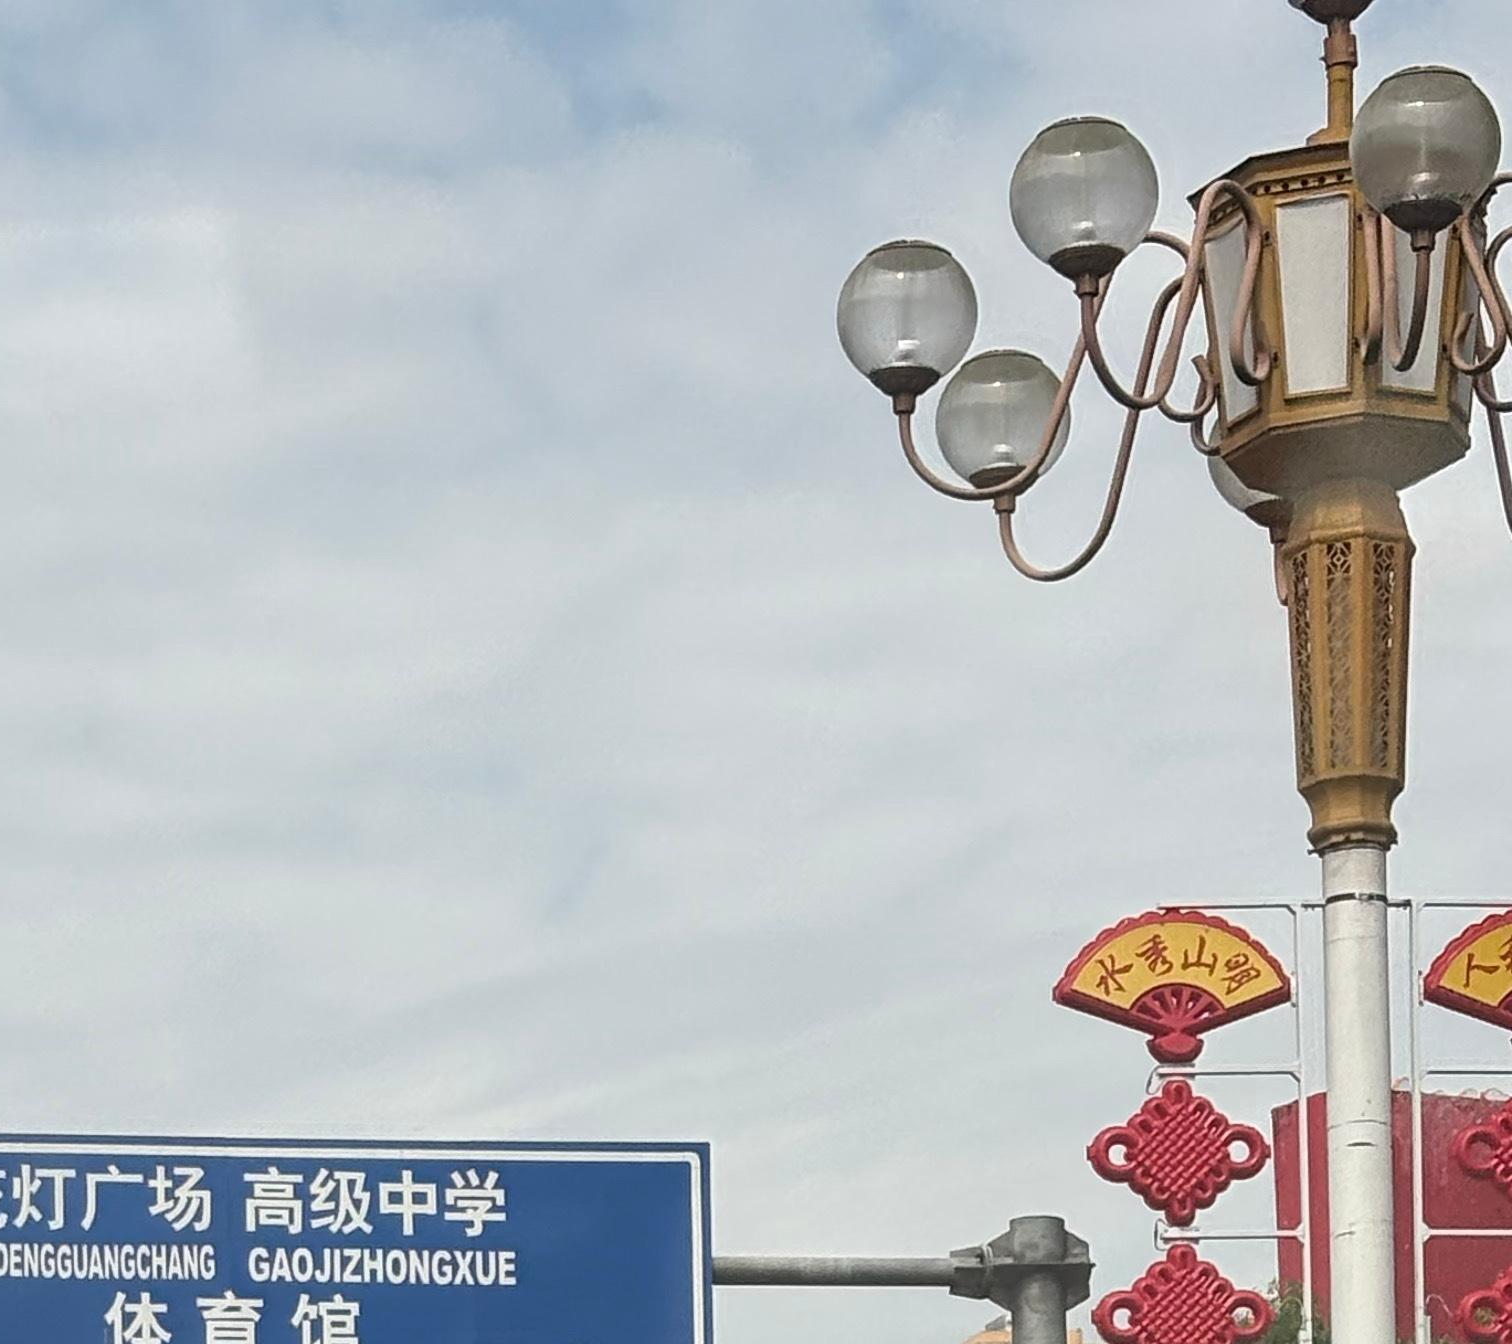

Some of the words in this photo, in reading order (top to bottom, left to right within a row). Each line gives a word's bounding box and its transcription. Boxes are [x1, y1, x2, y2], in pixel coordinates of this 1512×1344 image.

[243, 1167, 508, 1238] 高级中学
[248, 1247, 517, 1287] GAOJIZHONGXUE
